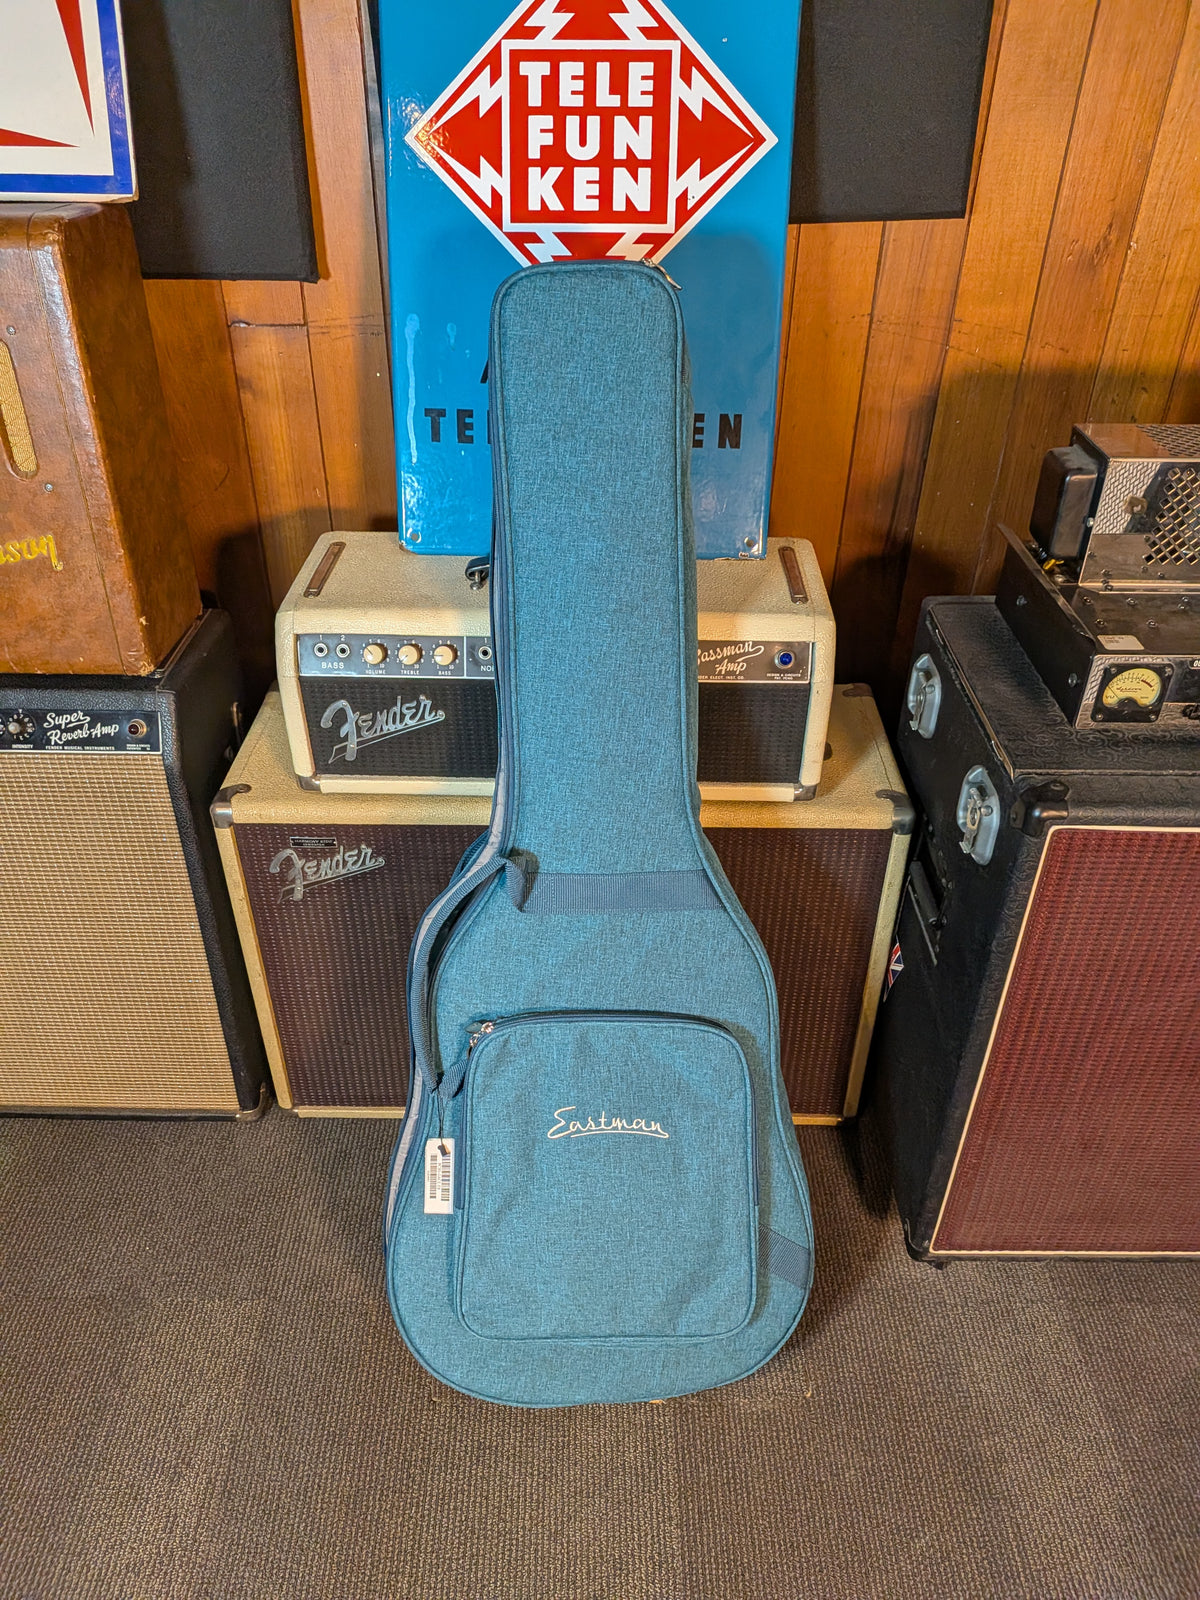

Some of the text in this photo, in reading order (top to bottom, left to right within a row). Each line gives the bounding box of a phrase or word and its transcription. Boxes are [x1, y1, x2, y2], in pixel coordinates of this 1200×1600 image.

[519, 61, 654, 108] TELE
[528, 115, 653, 160] FUN
[528, 167, 652, 211] KEN
[0, 534, 64, 571] son
[321, 661, 345, 669] BASS
[43, 710, 91, 729] Super
[320, 694, 446, 765] Fender
[269, 844, 386, 904] Fender
[547, 1105, 669, 1139] Eastman
